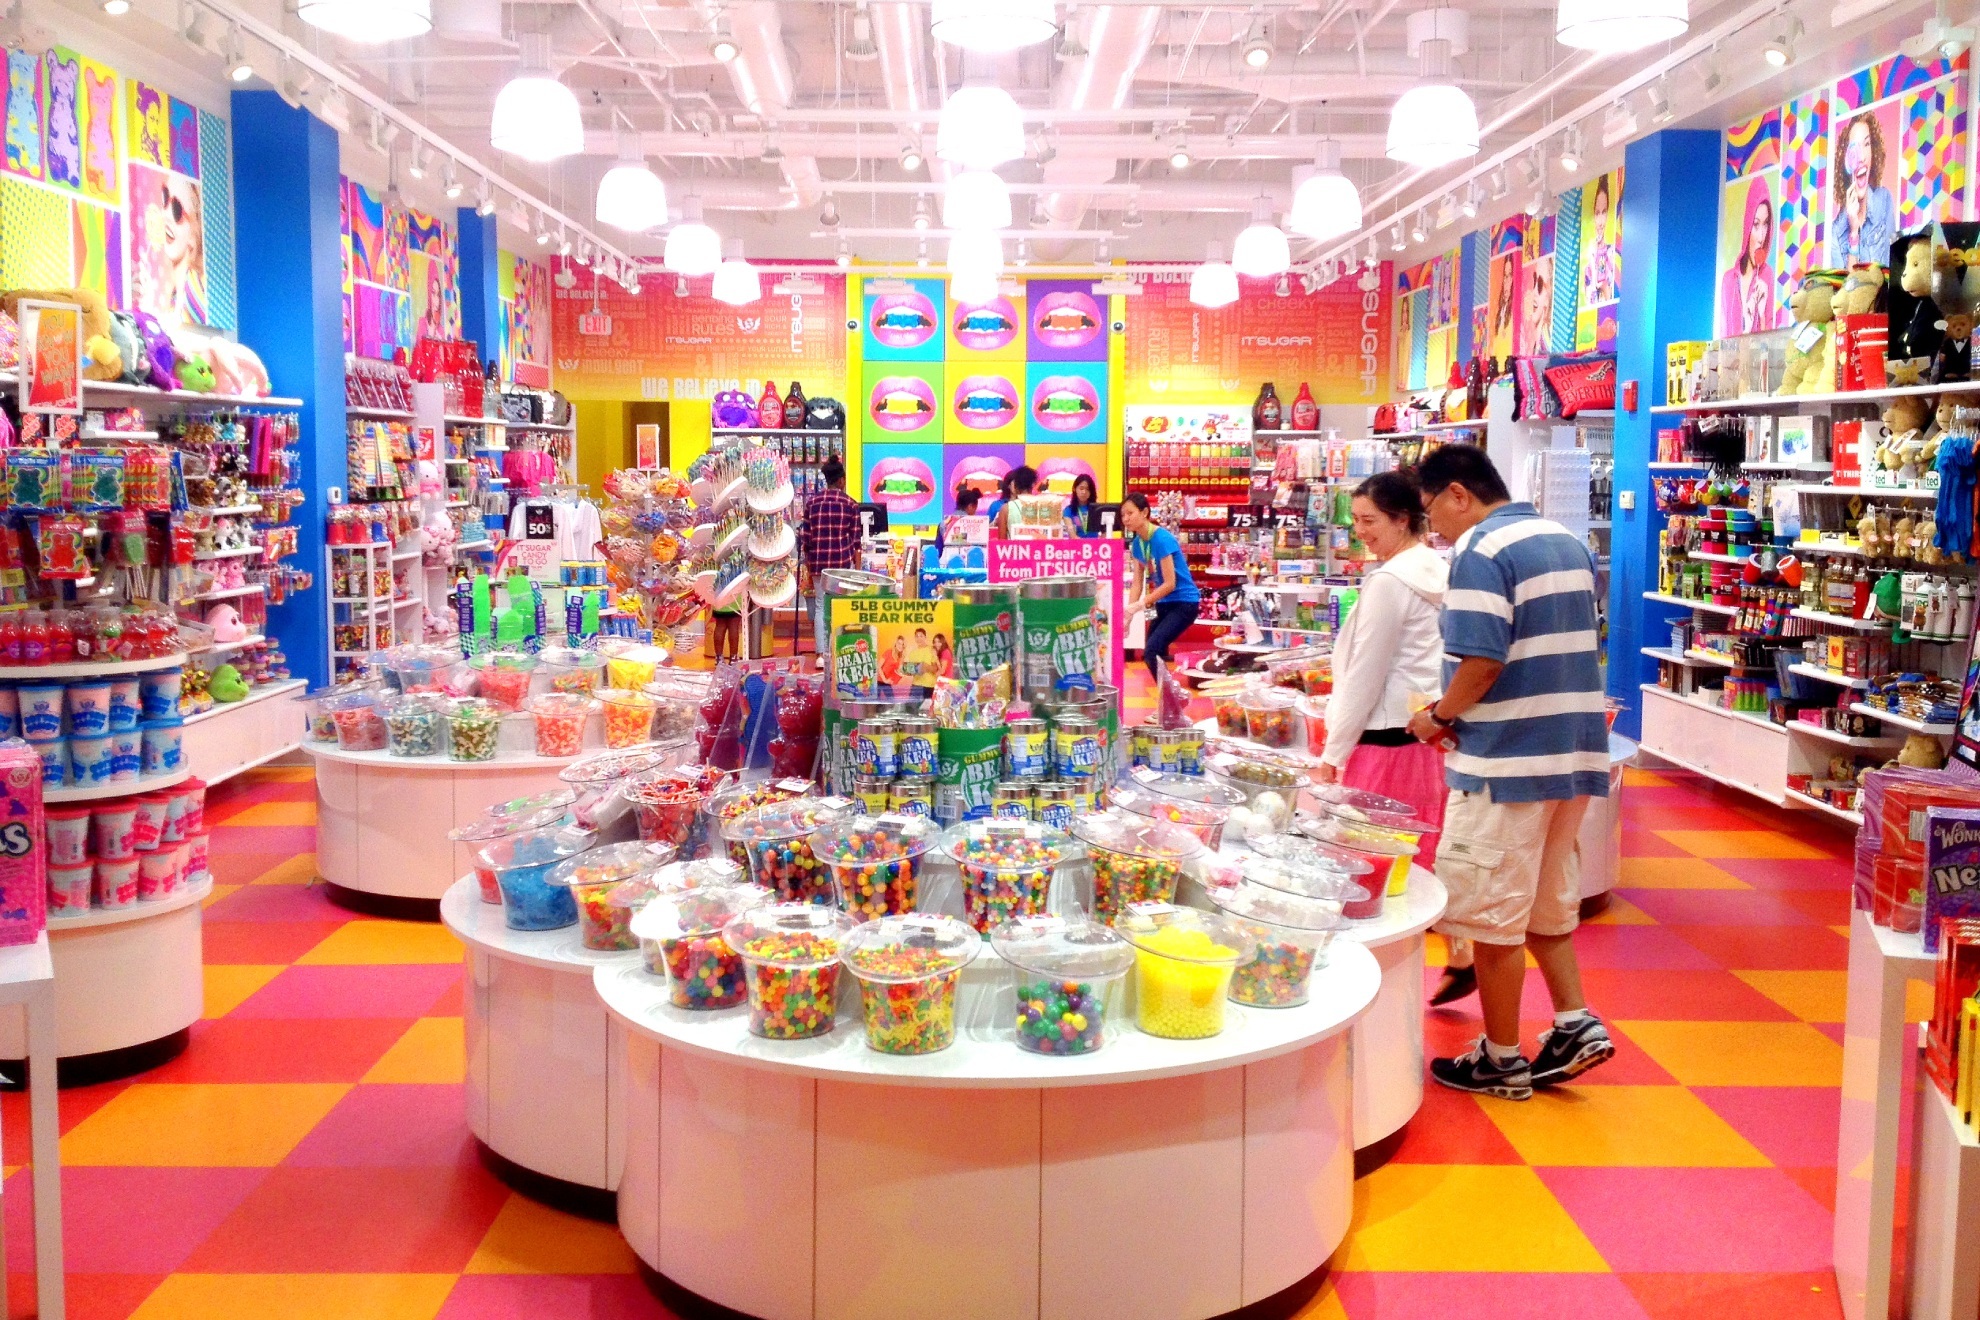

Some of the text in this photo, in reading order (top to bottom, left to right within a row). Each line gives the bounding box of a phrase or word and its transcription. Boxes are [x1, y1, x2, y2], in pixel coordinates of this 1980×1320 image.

[585, 315, 607, 333] EXIT
[1241, 336, 1312, 346] IT'SUGAR
[1554, 362, 1592, 379] QUEEN
[1561, 377, 1574, 391] OF
[1566, 384, 1615, 403] EVERYTHI
[1875, 474, 1886, 485] ted
[1926, 474, 1939, 486] ted
[996, 544, 1031, 560] WIN
[1034, 549, 1042, 560] a
[999, 562, 1033, 578] from
[851, 601, 939, 612] 5LB GUMMY
[859, 612, 934, 624] BEAR KEG
